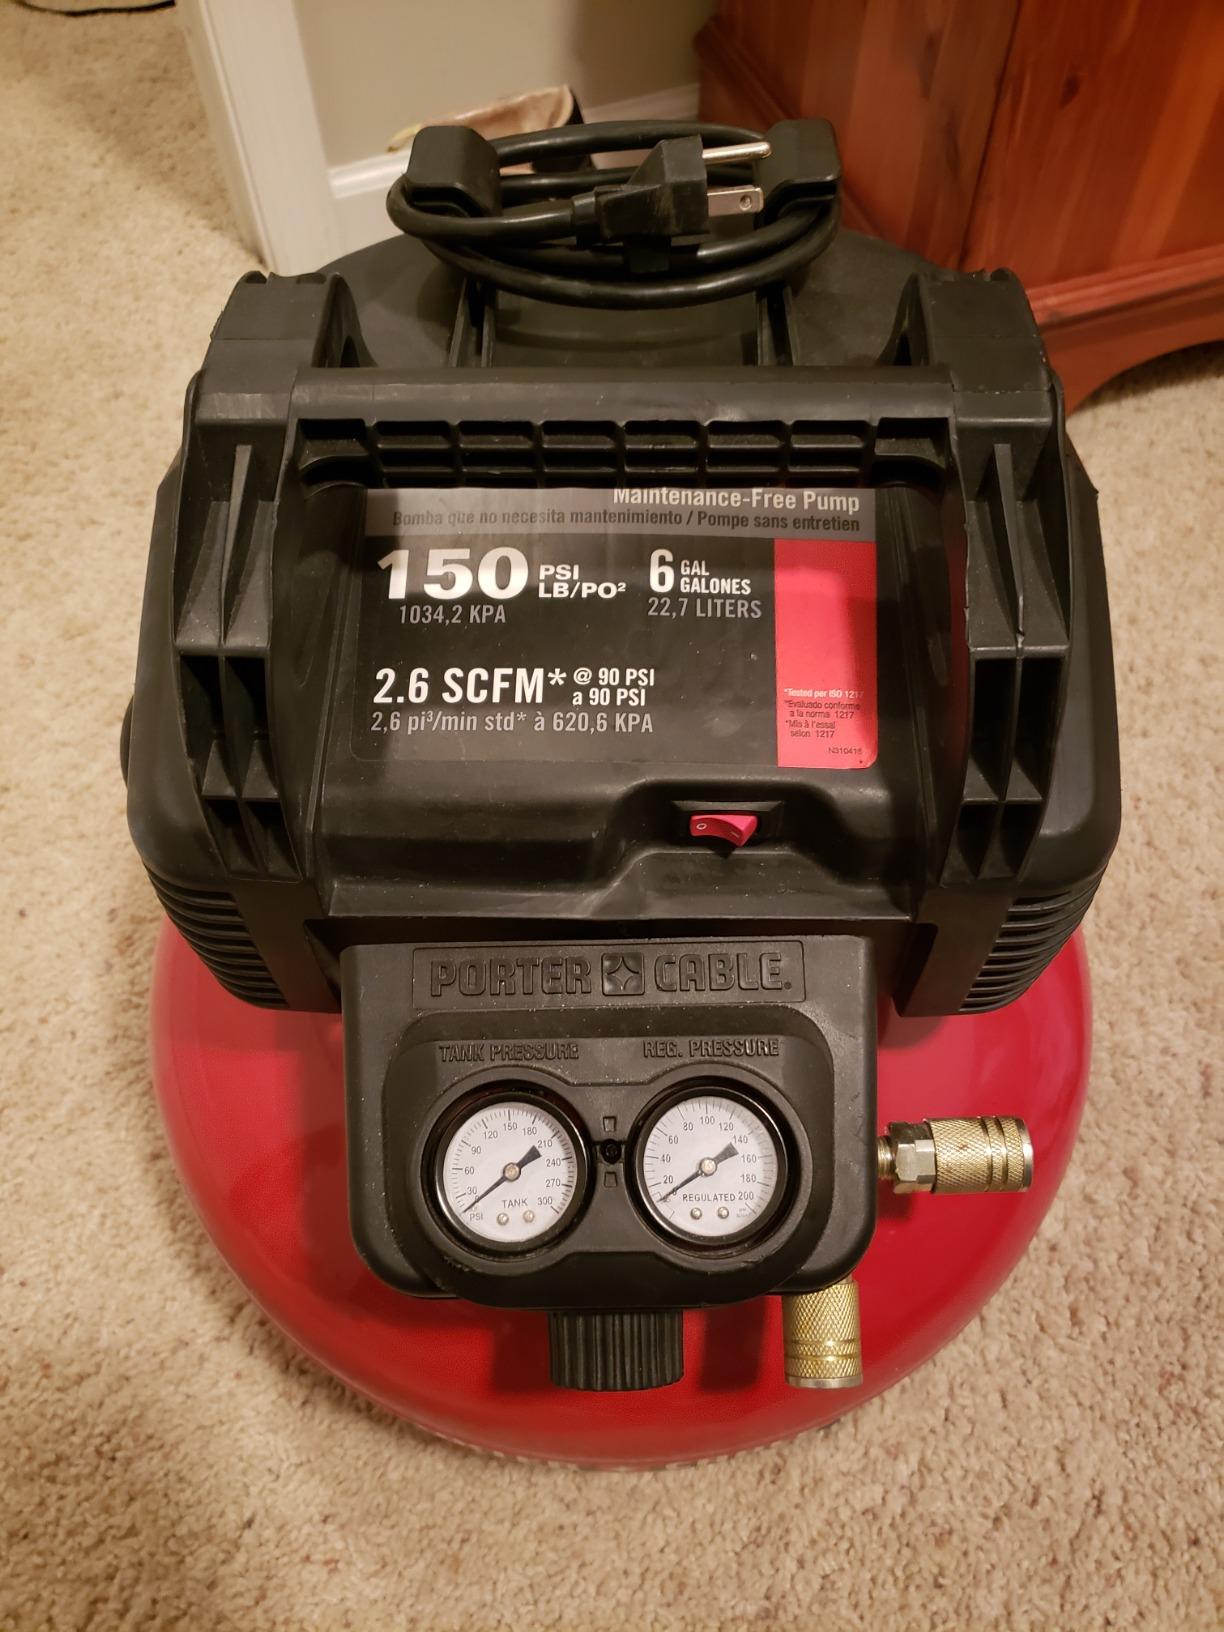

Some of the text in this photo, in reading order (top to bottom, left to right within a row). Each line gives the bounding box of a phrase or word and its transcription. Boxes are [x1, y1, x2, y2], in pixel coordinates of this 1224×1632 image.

[613, 487, 860, 515] Maintenance-Free Pump
[393, 509, 860, 532] Bomba que no necesita mantenimiento / Pompe sans entretien
[539, 564, 580, 580] PSI
[650, 549, 674, 593] 6
[680, 560, 709, 576] GAL
[377, 547, 529, 600] 150
[680, 577, 752, 595] GALONES
[648, 597, 762, 619] 22,7 LITERS
[400, 604, 506, 625] 1034,2 KPA
[373, 668, 429, 703] 2.6
[573, 667, 593, 685] @
[598, 668, 620, 686] 90
[625, 668, 655, 687] PSI
[572, 688, 646, 706] a 90 PSI
[814, 690, 826, 699] per
[828, 690, 842, 698] ISO
[824, 702, 861, 711] conforme
[797, 710, 803, 718] la
[835, 711, 855, 719] 1217
[370, 711, 401, 733] 2,6
[534, 712, 545, 731] à
[552, 711, 608, 734] 620,6
[615, 713, 653, 732] KPA
[791, 729, 835, 738] selon 1217
[430, 956, 592, 997] PORTER
[438, 1043, 580, 1062] TANK PRESSURE
[642, 1038, 780, 1058] REG. PRESSURE
[700, 1116, 715, 1125] 100
[503, 1122, 518, 1131] 150
[683, 1122, 694, 1131] 80
[719, 1122, 734, 1131] 120
[483, 1130, 498, 1139] 120
[523, 1127, 537, 1136] 180
[537, 1140, 552, 1148] 210
[668, 1136, 679, 1144] 60
[734, 1135, 748, 1144] 140
[471, 1146, 481, 1155] 90
[546, 1158, 561, 1167] 240
[660, 1154, 671, 1163] 40
[741, 1154, 756, 1163] 160
[464, 1166, 475, 1175] 60
[663, 1175, 673, 1184] 20
[740, 1174, 756, 1183] 180
[545, 1179, 560, 1188] 270
[467, 1187, 477, 1195] 30
[738, 1191, 754, 1200] 200
[537, 1196, 552, 1205] 300
[682, 1193, 736, 1202] REGULATED
[502, 1198, 528, 1208] TANK
[469, 1213, 484, 1221] PSI
